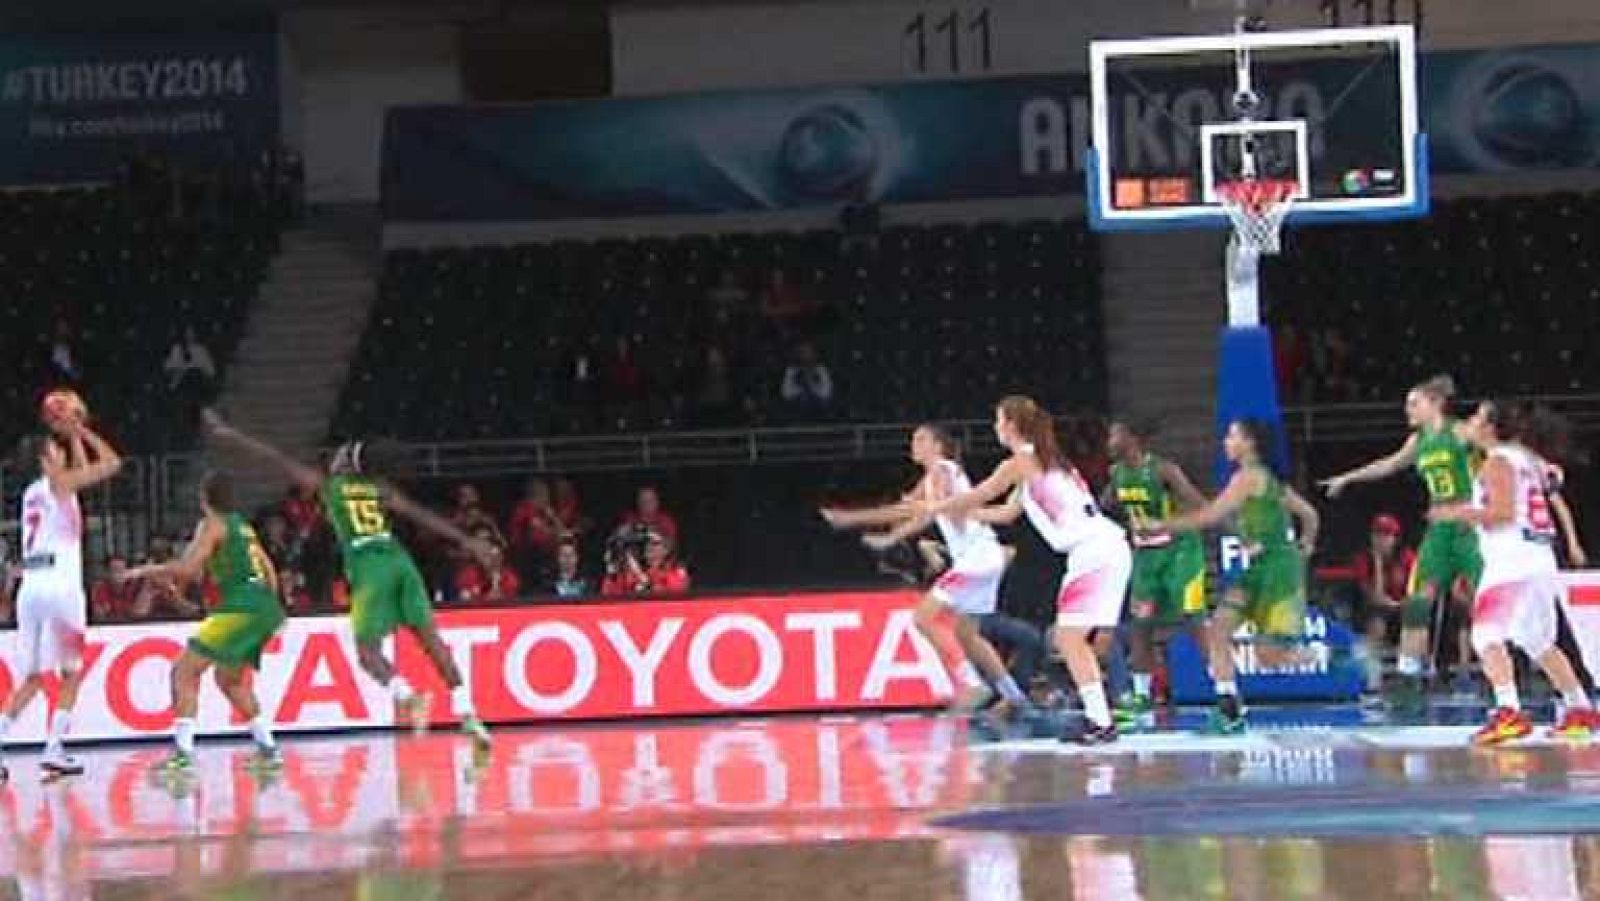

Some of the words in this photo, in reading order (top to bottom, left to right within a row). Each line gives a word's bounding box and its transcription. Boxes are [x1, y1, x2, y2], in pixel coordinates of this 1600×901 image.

[904, 8, 993, 73] 111
[3, 56, 249, 101] #TURKEY2014
[348, 499, 384, 534] 15
[0, 632, 370, 734] YOA
[438, 610, 956, 715] TOYOTA
